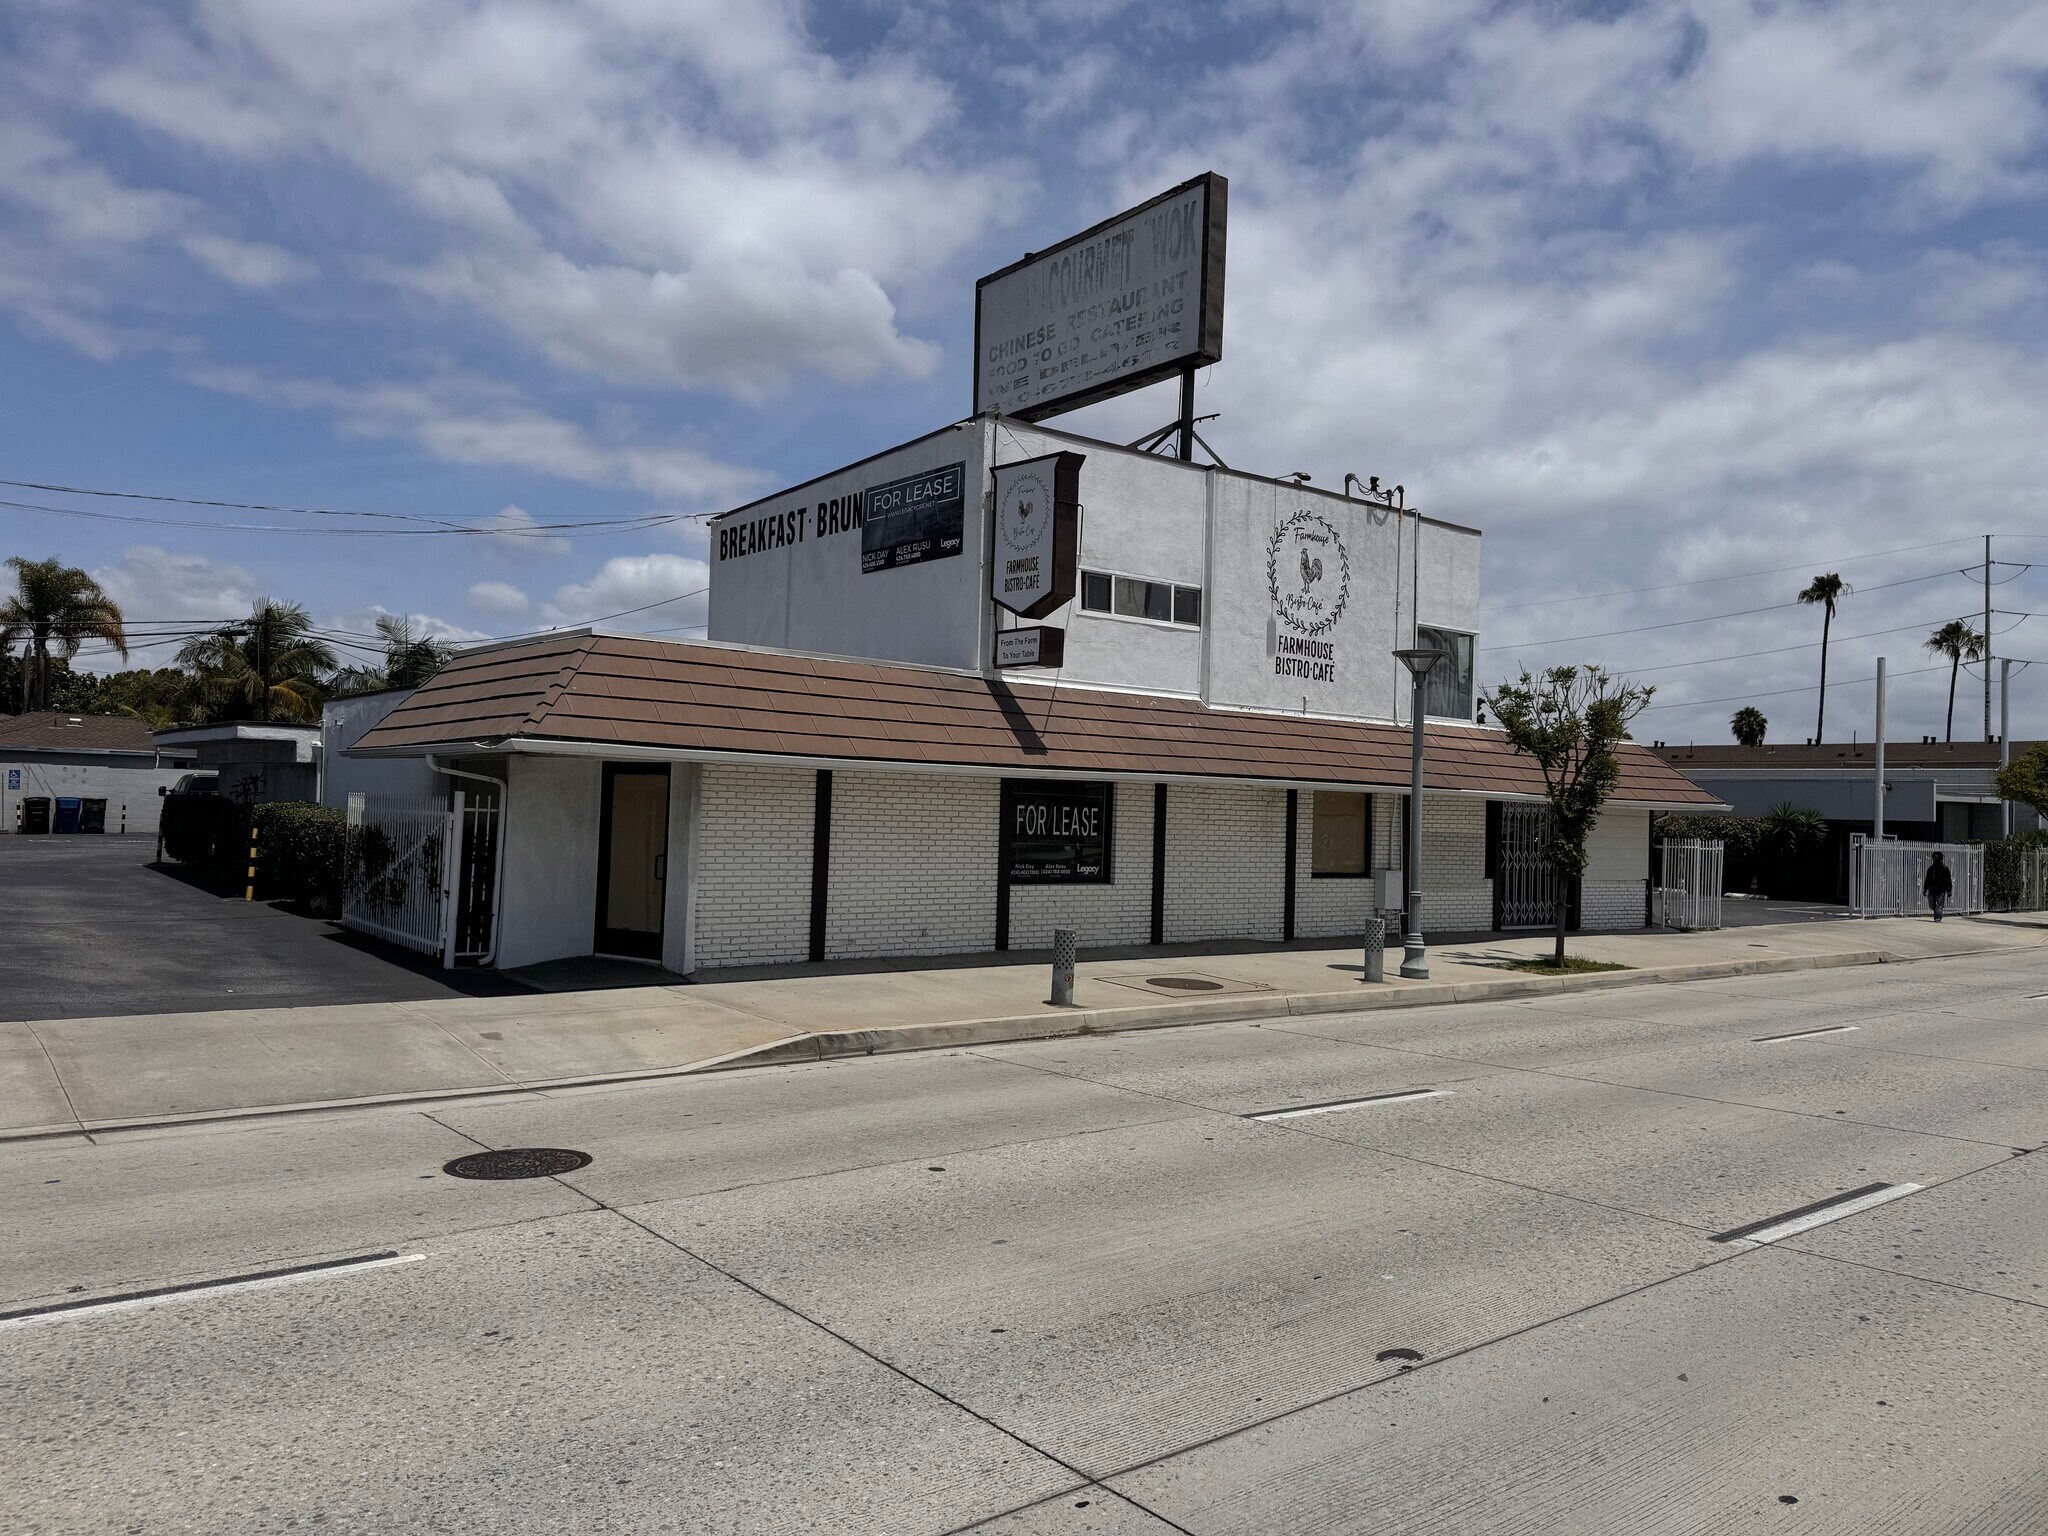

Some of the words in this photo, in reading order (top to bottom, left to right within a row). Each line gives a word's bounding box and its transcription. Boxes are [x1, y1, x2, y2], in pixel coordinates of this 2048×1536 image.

[988, 357, 1028, 379] FOOD
[1090, 298, 1184, 343] CATERING
[988, 322, 1057, 363] CHINESE
[873, 490, 902, 513] FOR
[905, 475, 953, 503] LEASE
[719, 507, 808, 562] BREAKFAST
[877, 549, 889, 559] DAY
[895, 544, 911, 555] ALEX
[912, 540, 931, 552] RUSU
[1005, 556, 1040, 575] FARMHOUSE
[1000, 639, 1014, 647] From
[1014, 637, 1024, 646] The
[1024, 636, 1038, 645] Farm
[1277, 634, 1335, 661] FARMHOUSE
[1002, 652, 1009, 660] To
[1009, 651, 1021, 659] Your
[1021, 649, 1035, 658] Table
[1016, 804, 1047, 836] FOR
[1052, 805, 1099, 837] LEASE
[1077, 863, 1100, 875] Legacy
